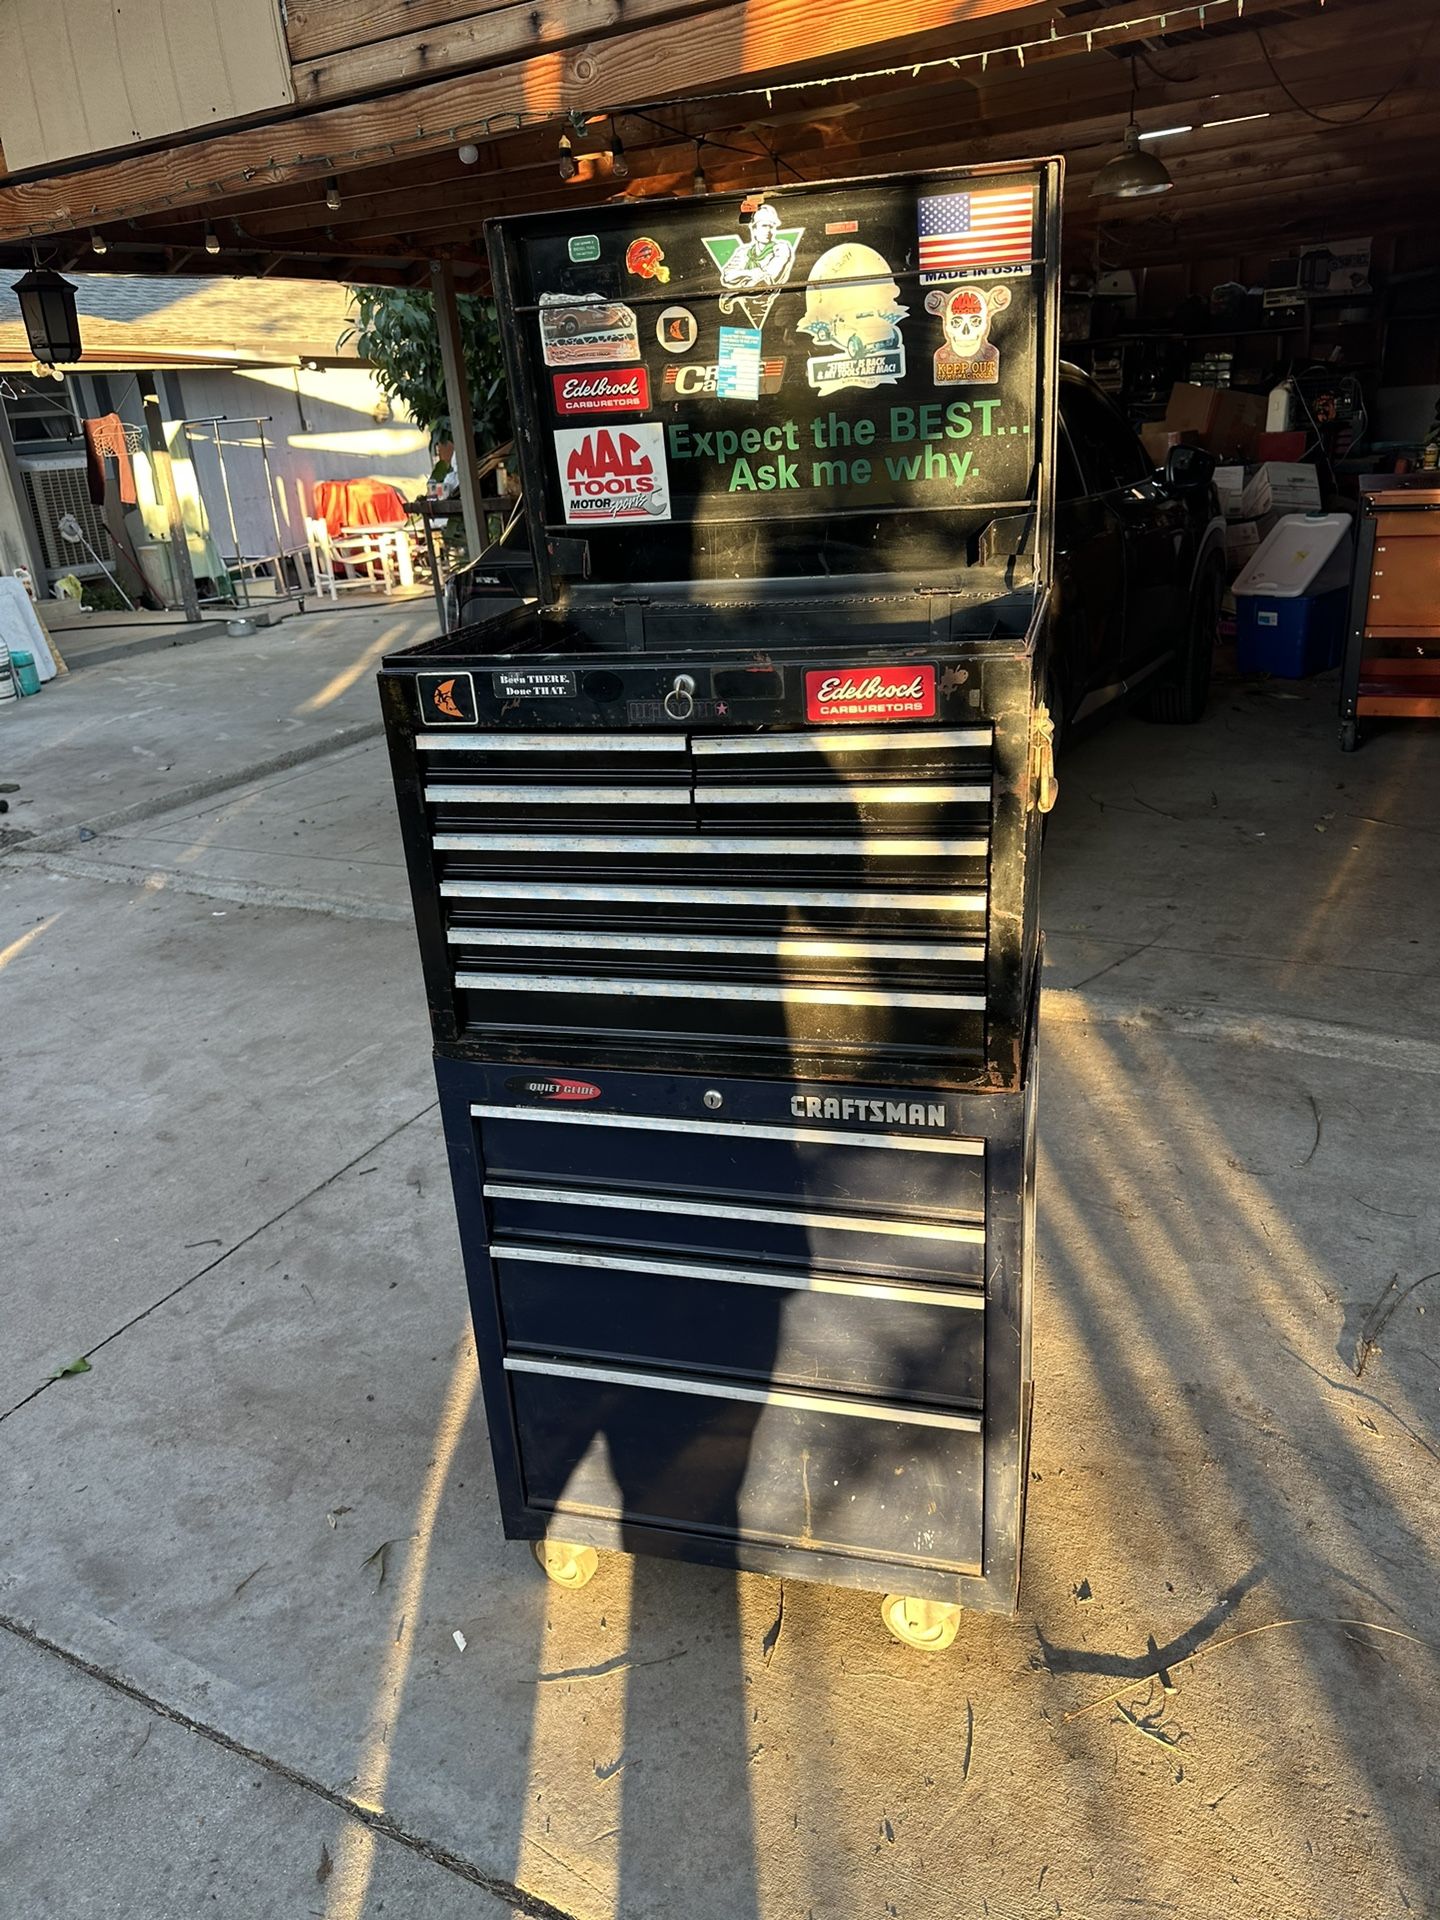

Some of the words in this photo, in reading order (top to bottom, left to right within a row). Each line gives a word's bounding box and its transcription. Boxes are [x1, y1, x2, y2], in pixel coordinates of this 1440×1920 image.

[925, 270, 967, 281] MADE
[973, 268, 987, 277] IN
[992, 265, 1023, 275] USA
[866, 357, 886, 367] BACK
[937, 361, 969, 375] KEEP
[971, 361, 995, 375] OUT
[837, 367, 860, 378] TOOLS
[860, 366, 876, 376] ARE
[562, 377, 640, 399] Edelbrock
[565, 397, 640, 409] CARBURETORS
[668, 419, 800, 464] Expect
[810, 412, 876, 448] the
[890, 399, 1030, 443] BEST...
[567, 429, 654, 480] MAC
[728, 455, 800, 492] Ask
[812, 458, 872, 487] me
[885, 444, 980, 488] why.
[568, 477, 655, 496] TOOLS
[500, 674, 526, 684] Been
[506, 687, 532, 696] Done
[533, 686, 567, 696] THAT.
[817, 676, 923, 702] Edelbrock
[820, 702, 923, 715] CARBURETORS
[529, 1082, 561, 1093] QUIET
[563, 1085, 595, 1096] GLIDE
[790, 1095, 946, 1127] CRAFTSMAN
